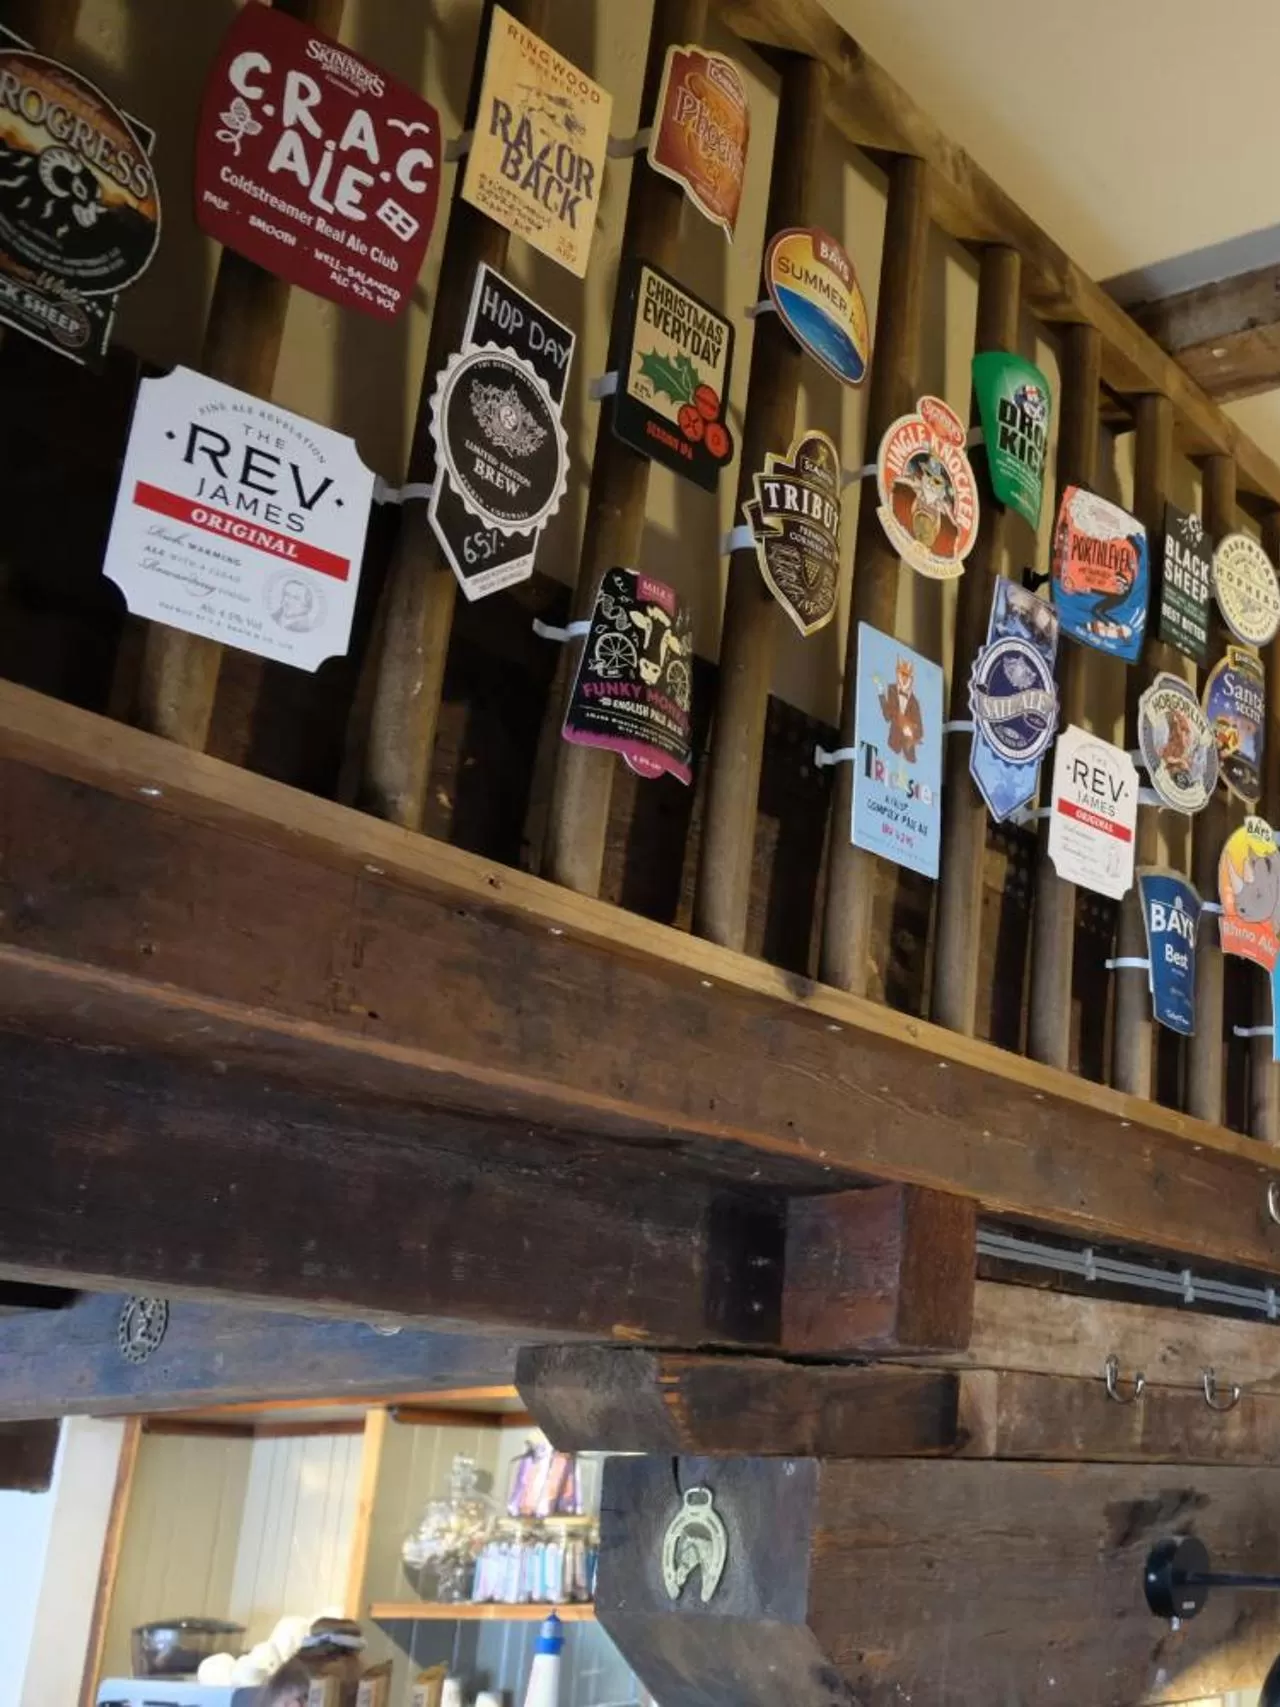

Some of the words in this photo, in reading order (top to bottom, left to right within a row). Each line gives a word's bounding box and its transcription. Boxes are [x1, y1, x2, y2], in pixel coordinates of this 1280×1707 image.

[305, 38, 385, 97] SKINNER'S
[507, 24, 600, 104] RINGWOOD
[0, 68, 152, 200] ROGRESS
[489, 96, 595, 200] RAZOR
[500, 142, 583, 231] BACK
[220, 166, 314, 227] Coldstreamer
[315, 215, 345, 244] Real
[346, 234, 368, 256] Ale
[370, 246, 399, 272] Club
[203, 190, 230, 211] PALE
[249, 215, 297, 247] SMOOTH
[314, 248, 401, 301] WELL-BALANCED
[819, 241, 850, 282] BAYS
[377, 295, 397, 313] VOL
[777, 256, 848, 311] SUMMER
[24, 294, 81, 333] SHEEP
[482, 286, 523, 336] HOP
[529, 317, 571, 370] DAY
[643, 300, 722, 370] EVERYDAY
[647, 276, 724, 346] CHRISTMAS
[244, 423, 285, 450] THE
[184, 422, 334, 511] REV
[464, 439, 499, 466] LIMITED
[500, 461, 532, 488] EDITION
[473, 456, 521, 497] BREW
[197, 477, 305, 533] JAMES
[764, 482, 839, 537] TRIBUT
[191, 507, 298, 559] ORIGINAL
[1164, 557, 1209, 605] SHEEP
[1166, 534, 1209, 585] BLACK
[581, 681, 642, 698] FUNKY
[612, 699, 649, 718] ENGLISH
[650, 708, 667, 726] PALE
[1073, 758, 1124, 803] REV
[1076, 790, 1116, 817] JAMES
[1150, 903, 1195, 949] BAYS
[1164, 943, 1189, 970] Best
